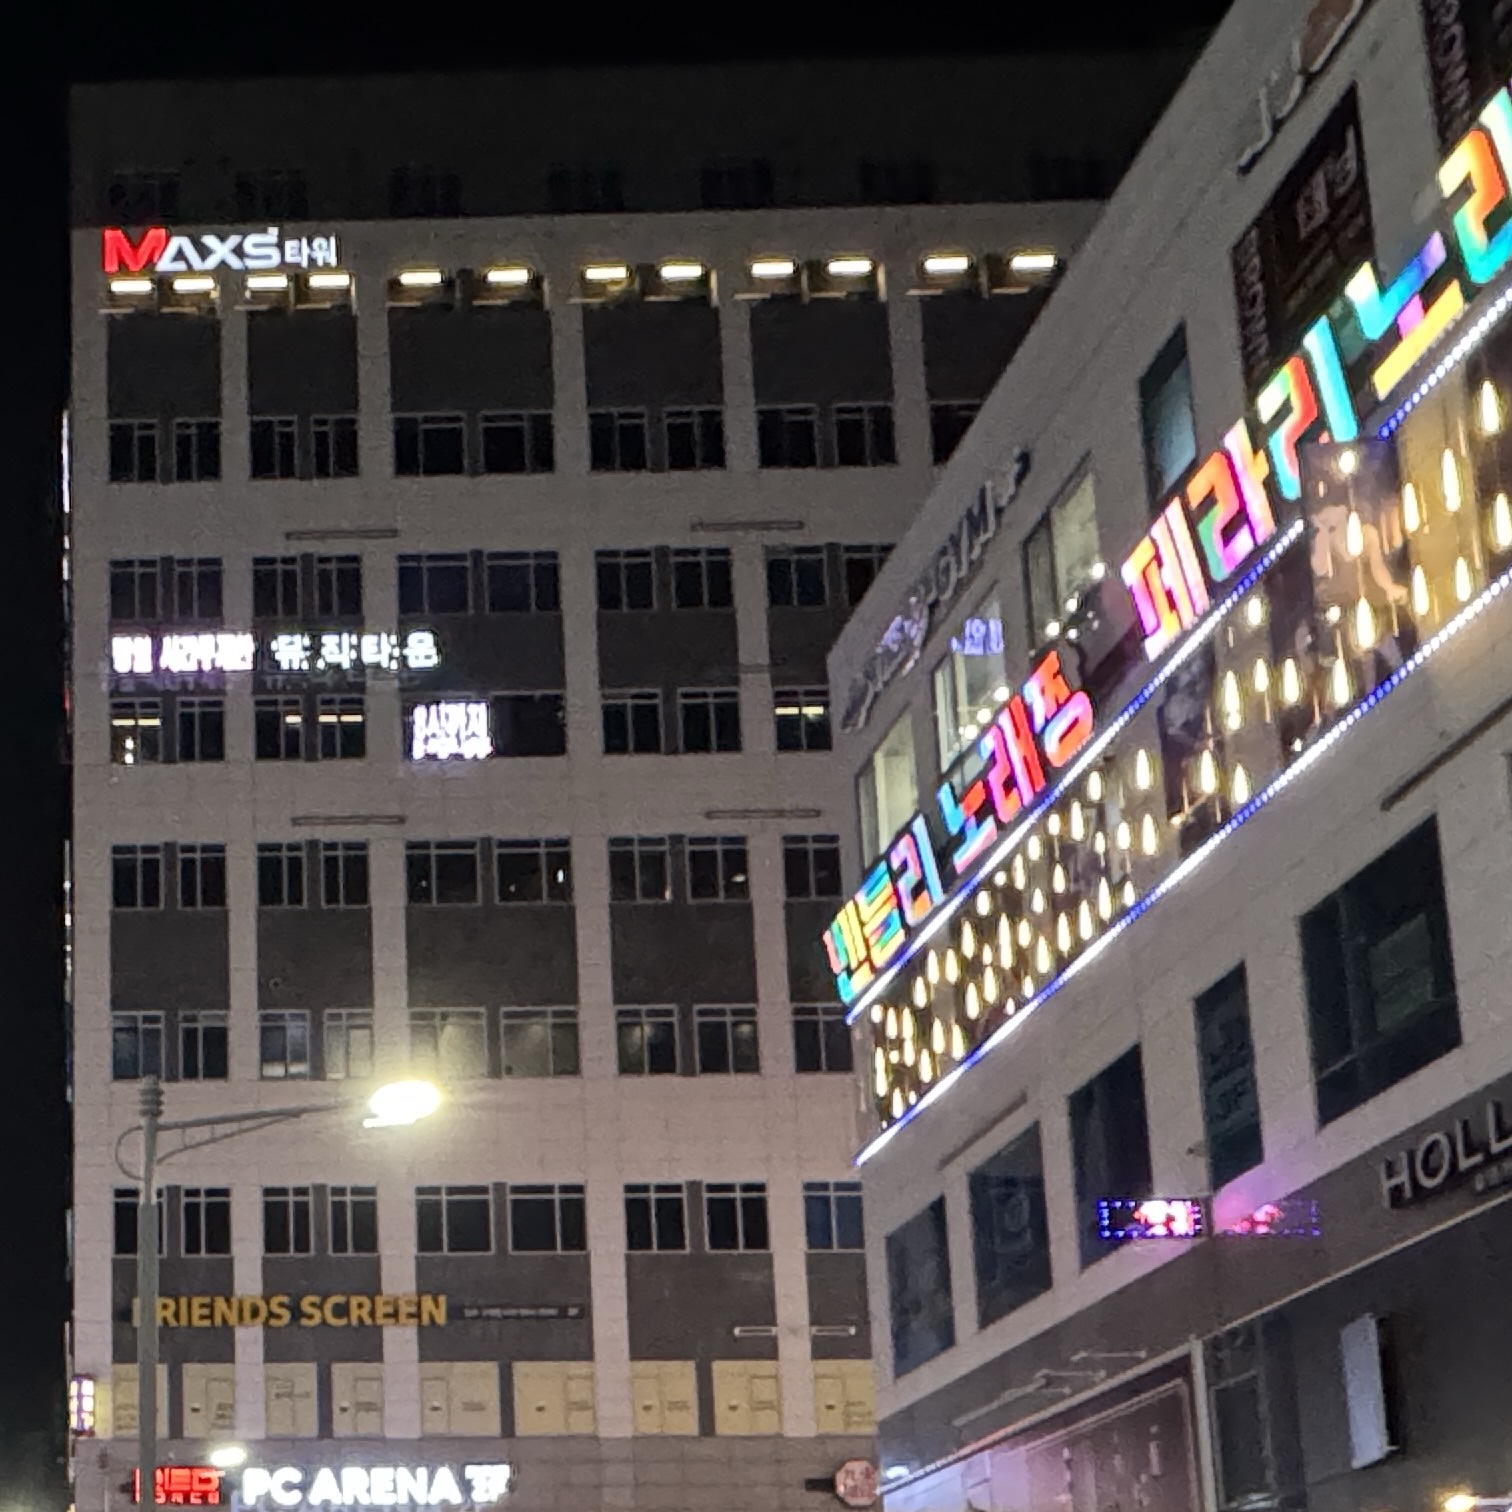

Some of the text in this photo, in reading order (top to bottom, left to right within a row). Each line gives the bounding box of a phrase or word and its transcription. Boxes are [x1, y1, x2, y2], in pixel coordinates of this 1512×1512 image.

[1121, 308, 1360, 664] 페라리
[133, 1296, 291, 1328] RIENDS
[299, 1295, 447, 1327] SCREEN
[242, 1468, 303, 1504] PC
[308, 1466, 464, 1504] ARENA
